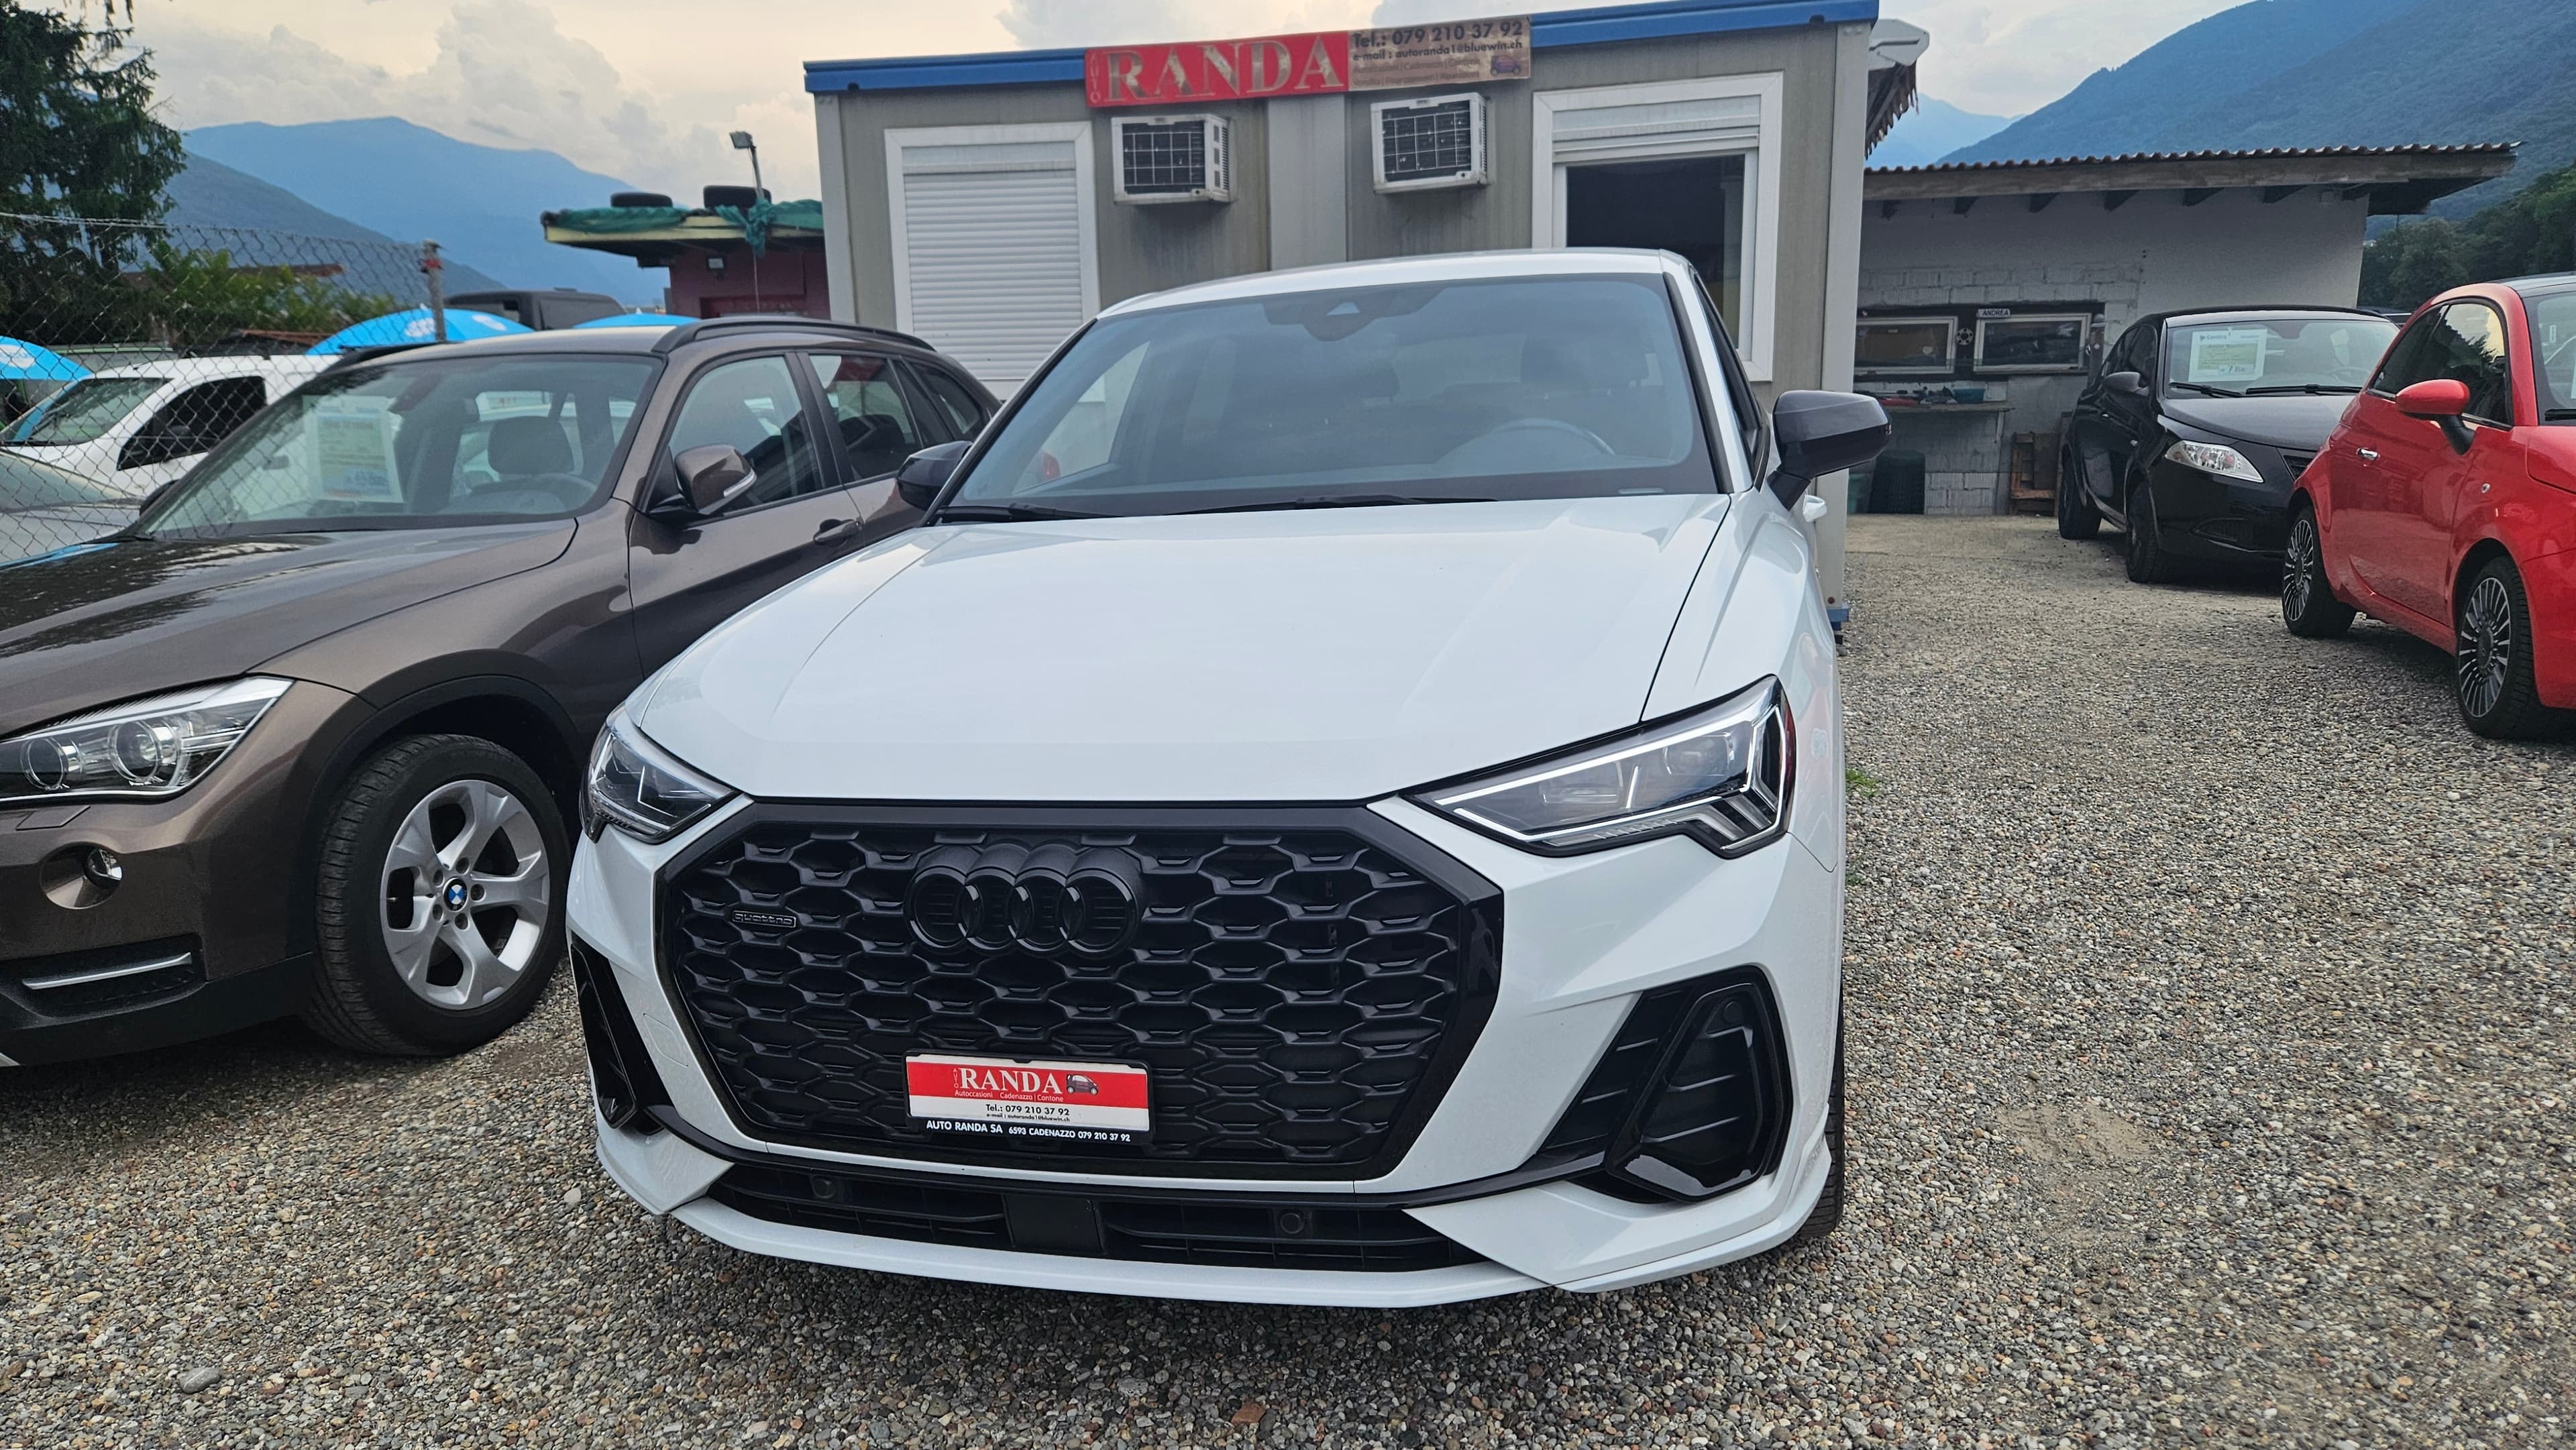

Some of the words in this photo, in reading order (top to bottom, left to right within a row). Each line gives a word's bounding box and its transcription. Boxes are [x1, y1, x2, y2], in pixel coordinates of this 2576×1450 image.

[1352, 32, 1386, 48] Tel.:
[1392, 28, 1426, 46] 079
[1432, 25, 1464, 42] 210
[1471, 23, 1493, 39] 37
[1501, 21, 1523, 36] 92
[1353, 50, 1386, 61] e-mail
[1395, 40, 1523, 59] autoranda1@bluewin.ch
[1102, 36, 1344, 102] RANDA
[735, 913, 793, 925] quattro
[959, 1068, 1063, 1095] RANDA
[955, 1091, 993, 1099] Autoccasioni
[1000, 1092, 1033, 1101] Cadenazzo
[1037, 1094, 1064, 1103] Contone
[985, 1104, 1003, 1112] Tel.:
[1024, 1106, 1041, 1114] 210
[1058, 1108, 1070, 1116] 92
[926, 1120, 952, 1131] AUTO
[955, 1123, 988, 1133] RANDA
[990, 1123, 1003, 1133] SA
[1008, 1127, 1026, 1135] 6593
[1029, 1128, 1075, 1138] CADENAZZO
[1077, 1131, 1091, 1139] 079
[1094, 1131, 1107, 1140] 210
[1109, 1133, 1118, 1141] 37
[1120, 1133, 1130, 1141] 92
